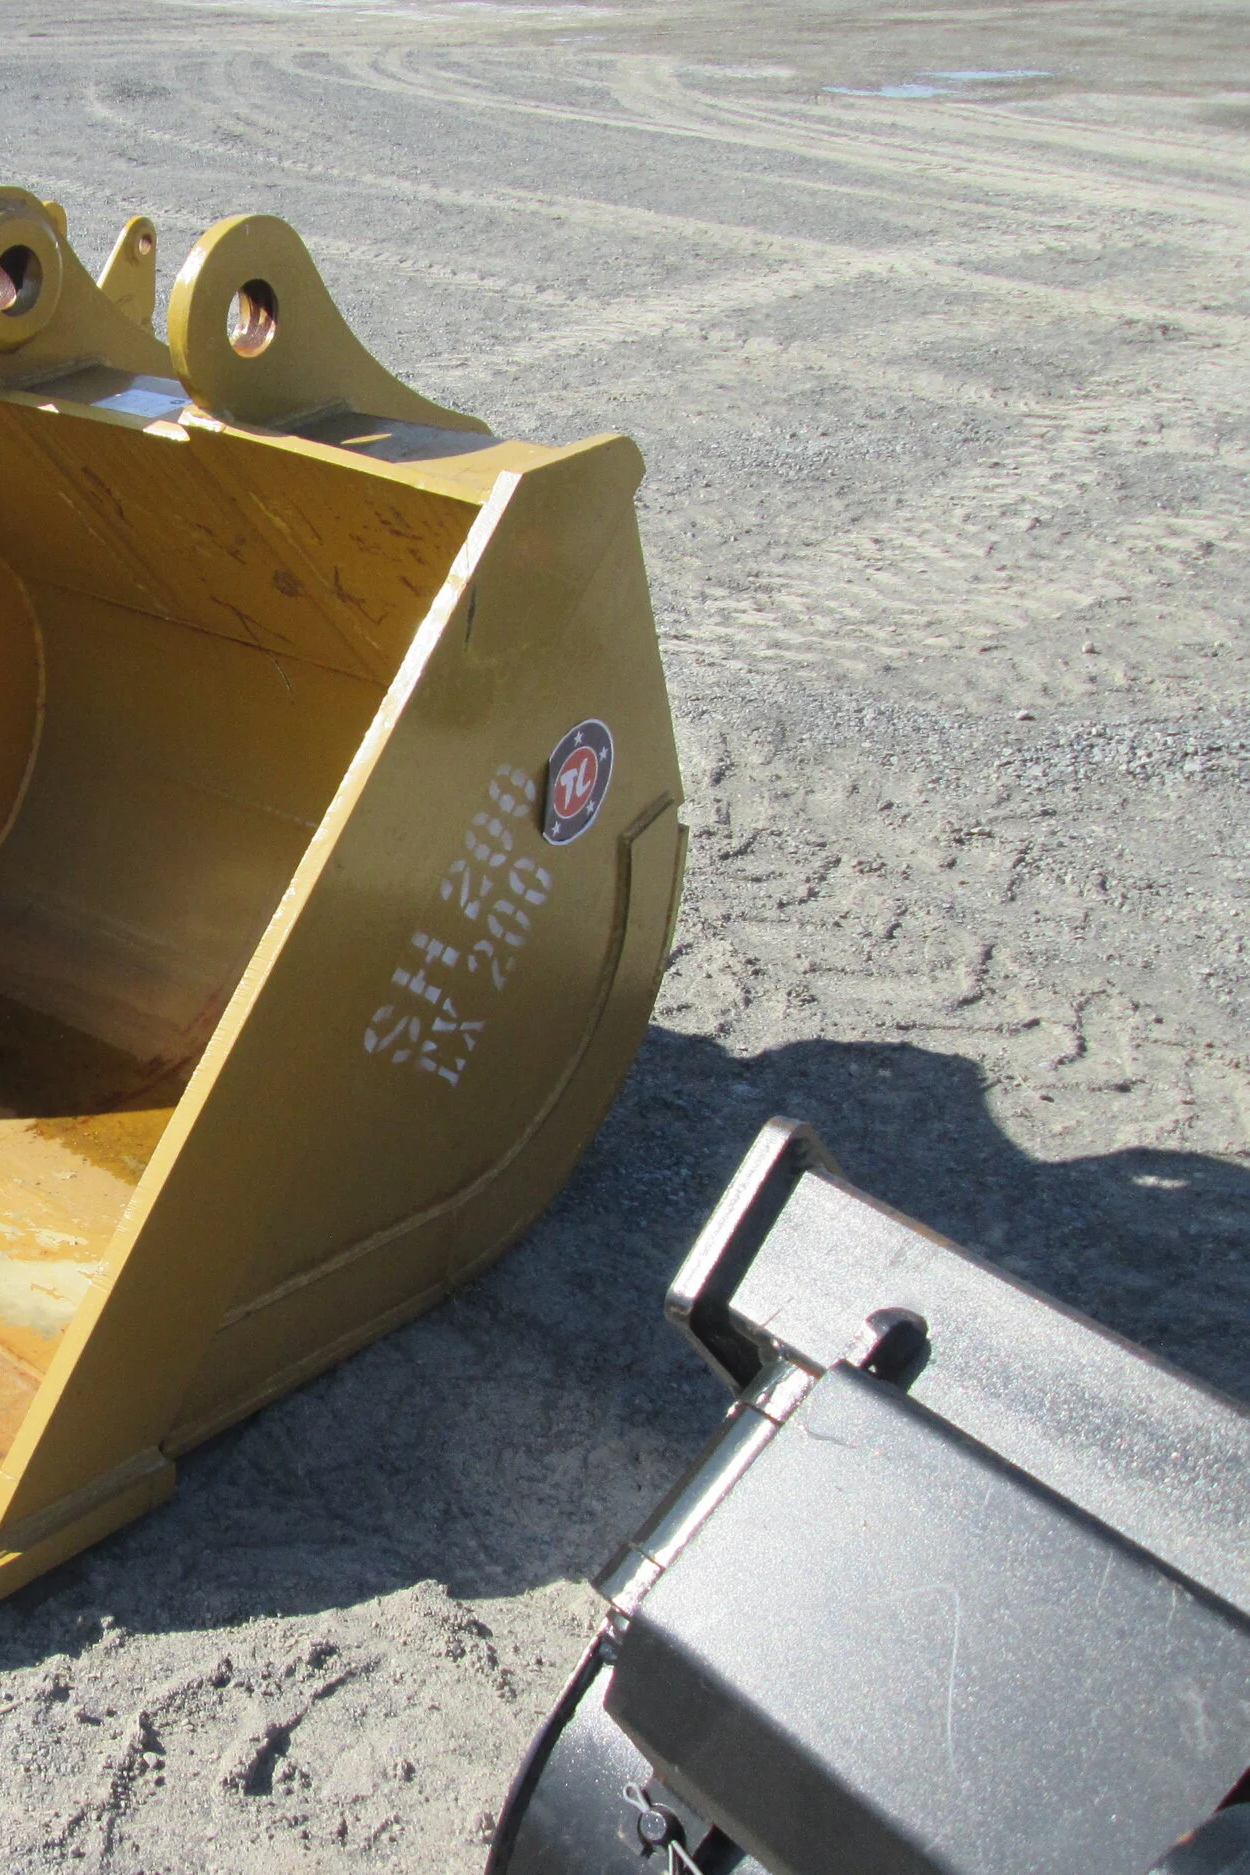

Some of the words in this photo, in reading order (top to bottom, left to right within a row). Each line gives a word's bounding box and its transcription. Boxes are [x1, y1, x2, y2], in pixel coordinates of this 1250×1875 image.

[364, 931, 460, 1063] SH
[440, 763, 536, 920] 200
[467, 857, 550, 991] 200
